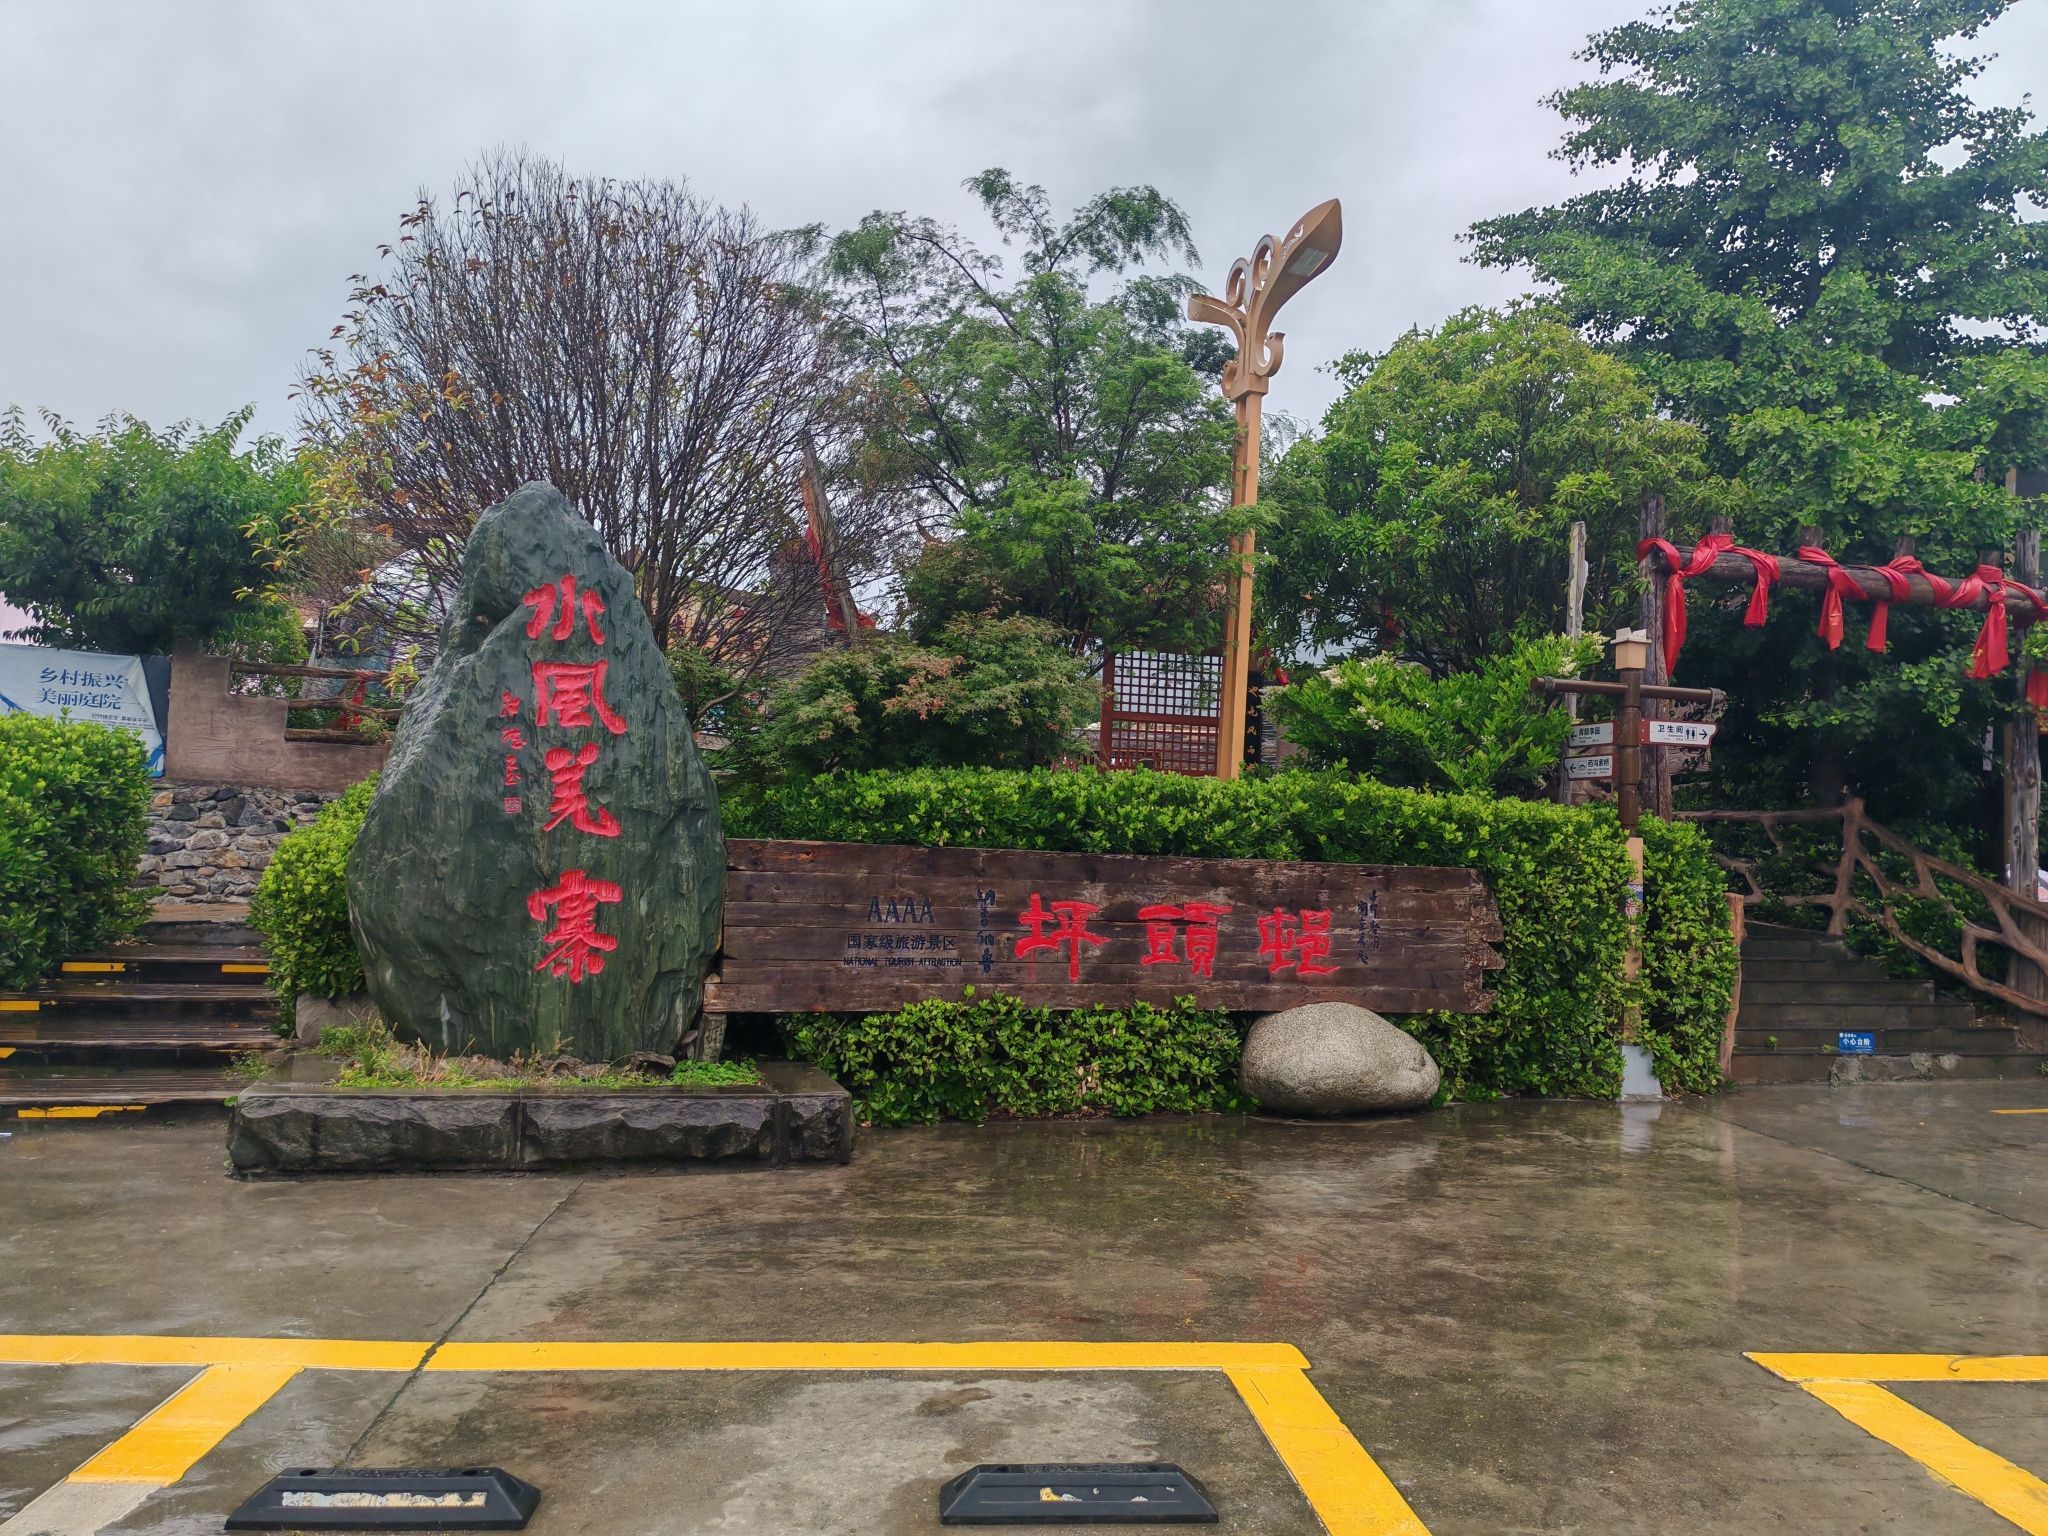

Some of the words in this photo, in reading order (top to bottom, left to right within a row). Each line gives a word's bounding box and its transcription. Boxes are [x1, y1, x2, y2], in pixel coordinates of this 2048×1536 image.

[38, 667, 129, 690] 乡村振兴
[35, 688, 122, 711] 美丽庭院
[1658, 724, 1683, 734] 卫生间
[866, 895, 935, 924] AAAA
[847, 933, 958, 951] 国家级旅游景区
[843, 956, 878, 967] NATIONAL
[884, 956, 915, 968] TOURIST
[918, 956, 962, 968] ATTRACTION
[1842, 1038, 1871, 1046] 小心台阶
